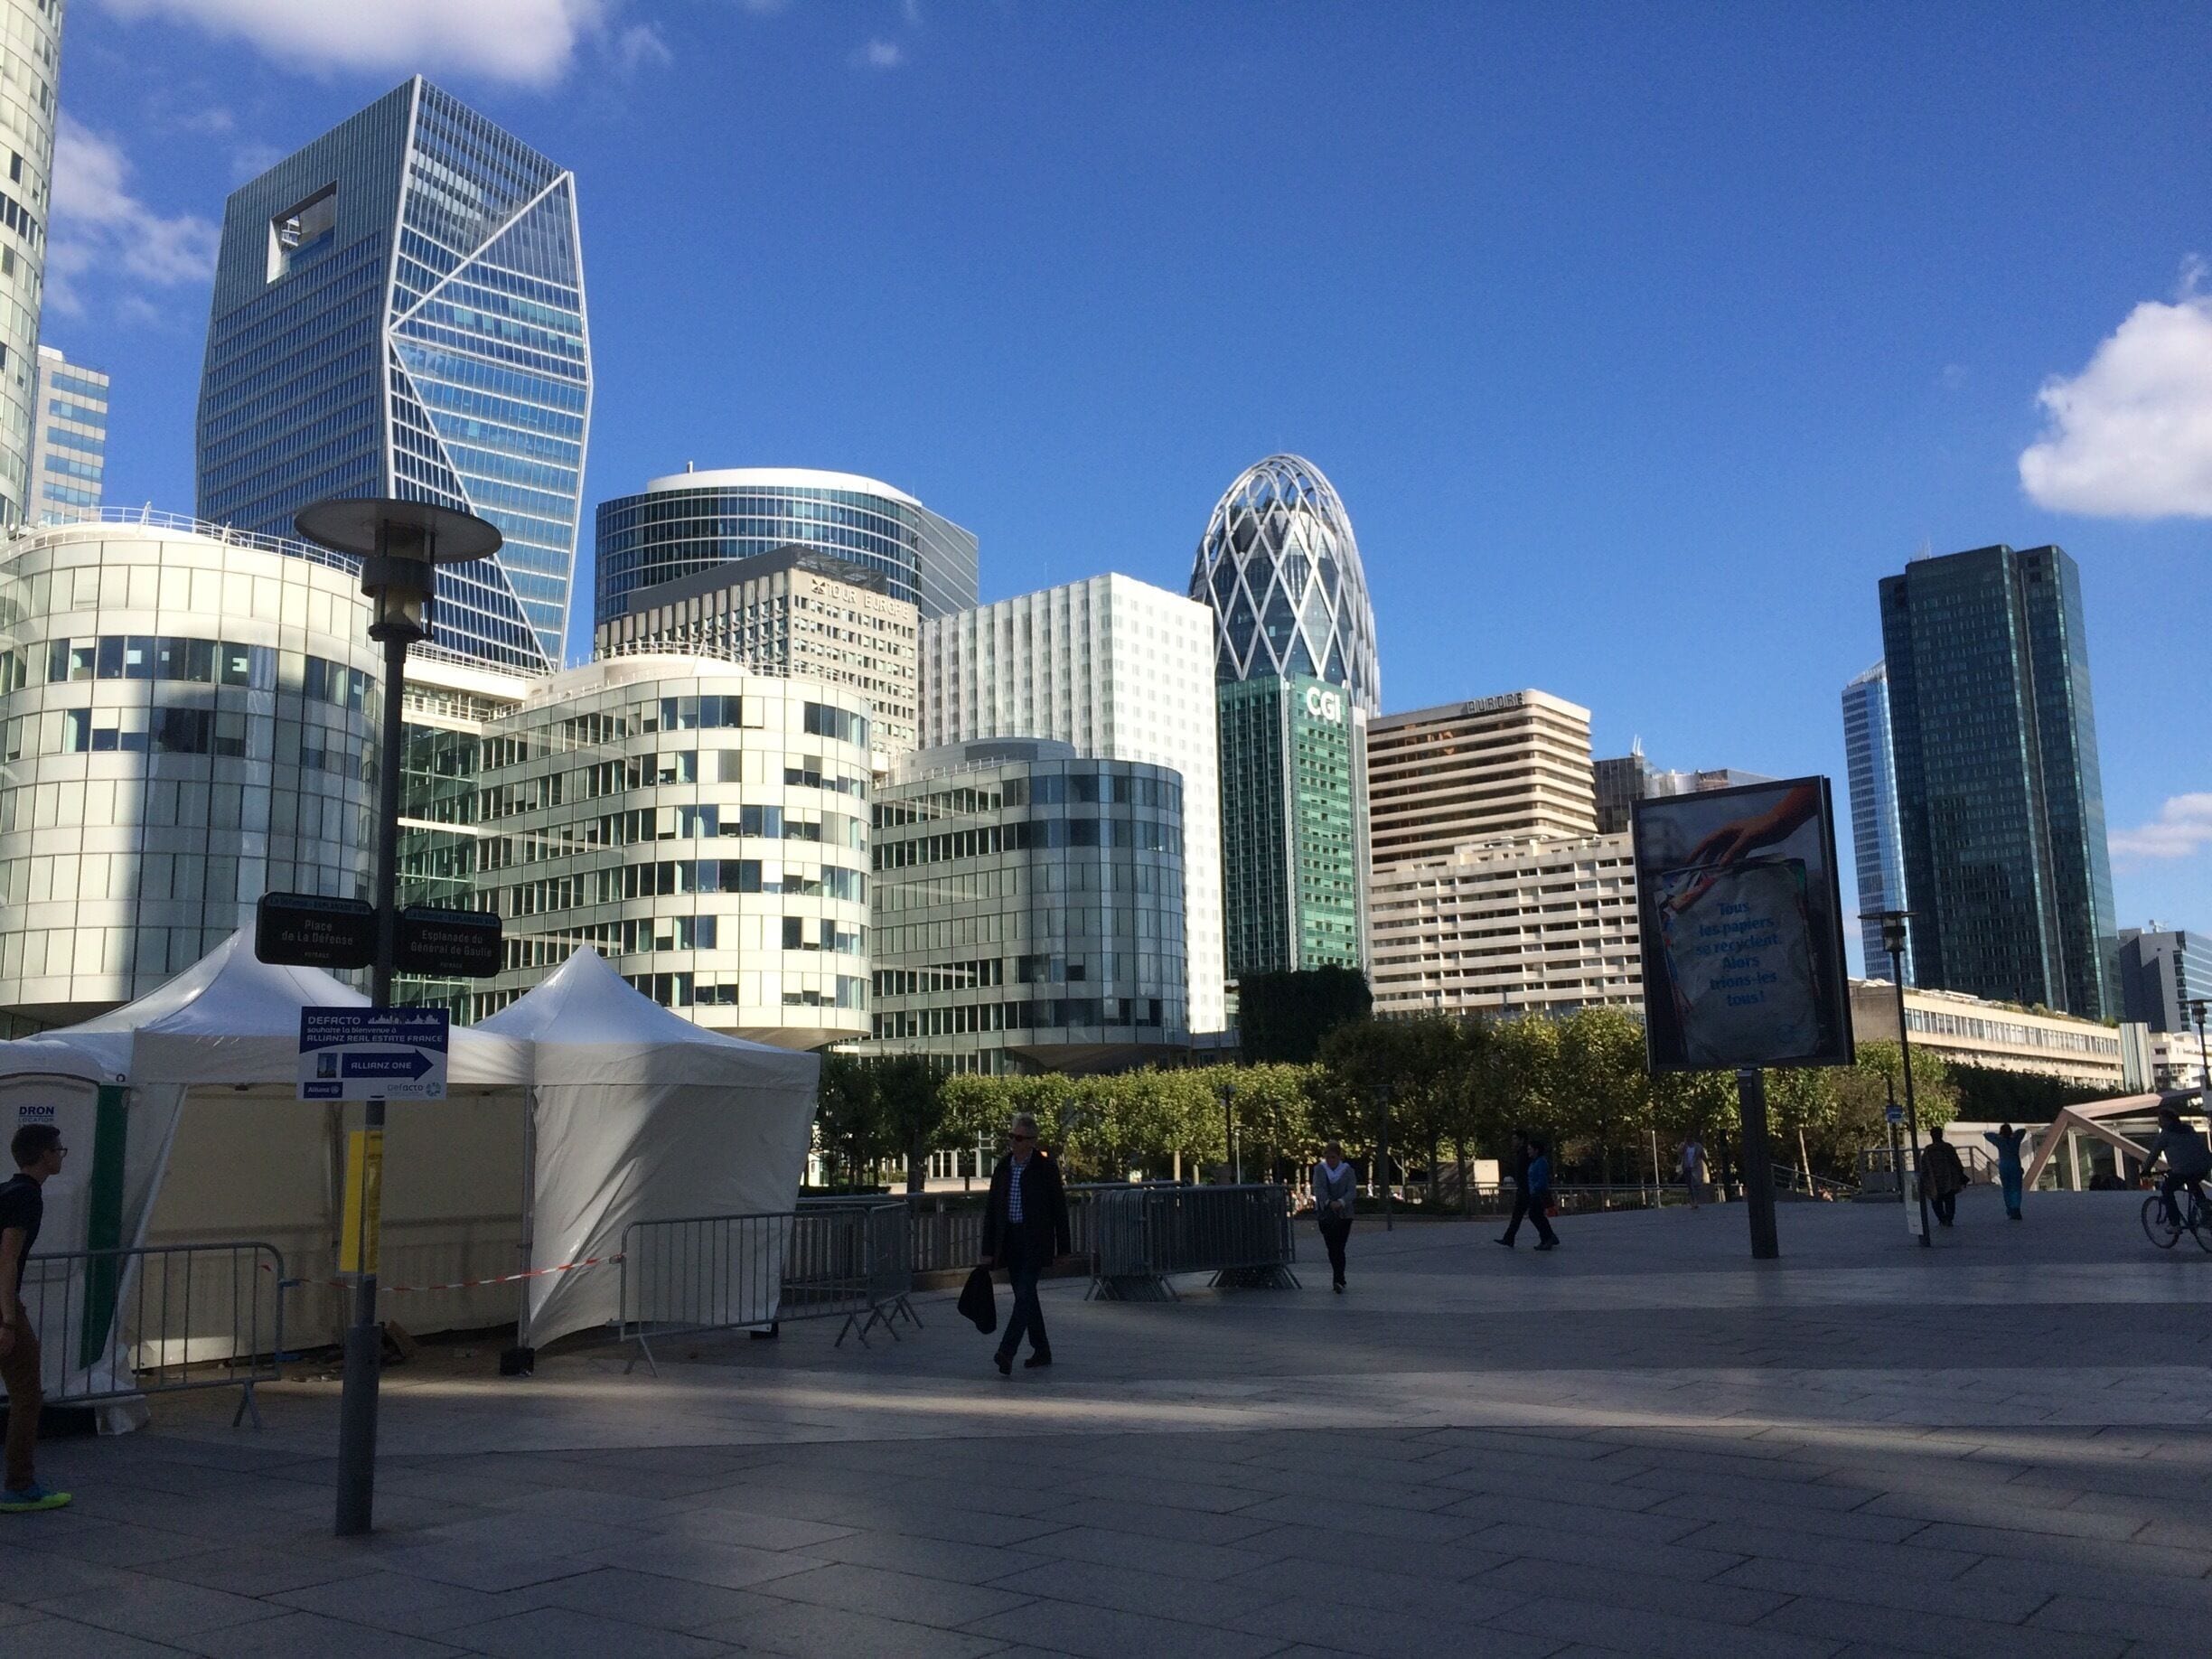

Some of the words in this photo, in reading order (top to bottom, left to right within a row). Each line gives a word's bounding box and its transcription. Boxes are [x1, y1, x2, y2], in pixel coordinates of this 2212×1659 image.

[826, 583, 857, 604] TOUR
[864, 592, 909, 620] EUROPE
[1307, 687, 1341, 723] CGI
[1467, 692, 1523, 714] AURORE
[1719, 902, 1750, 916] Tous
[305, 919, 333, 932] Place
[1699, 923, 1720, 937] les
[1722, 916, 1775, 936] papiers
[282, 931, 295, 941] de
[297, 932, 309, 942] La
[312, 932, 353, 945] Défense
[421, 929, 470, 942] Esplanade
[472, 933, 483, 944] du
[410, 941, 448, 954] Général
[450, 944, 462, 955] de
[464, 945, 492, 957] Gaulle
[1695, 944, 1711, 955] se
[1721, 956, 1760, 970] Alors
[1710, 971, 1777, 990] trions-les
[307, 1017, 361, 1025] DEFACTO
[407, 1035, 443, 1043] FRANCE
[351, 1062, 389, 1070] ALLIANZ
[307, 1085, 330, 1093] Allianz
[19, 1106, 54, 1115] DRON
